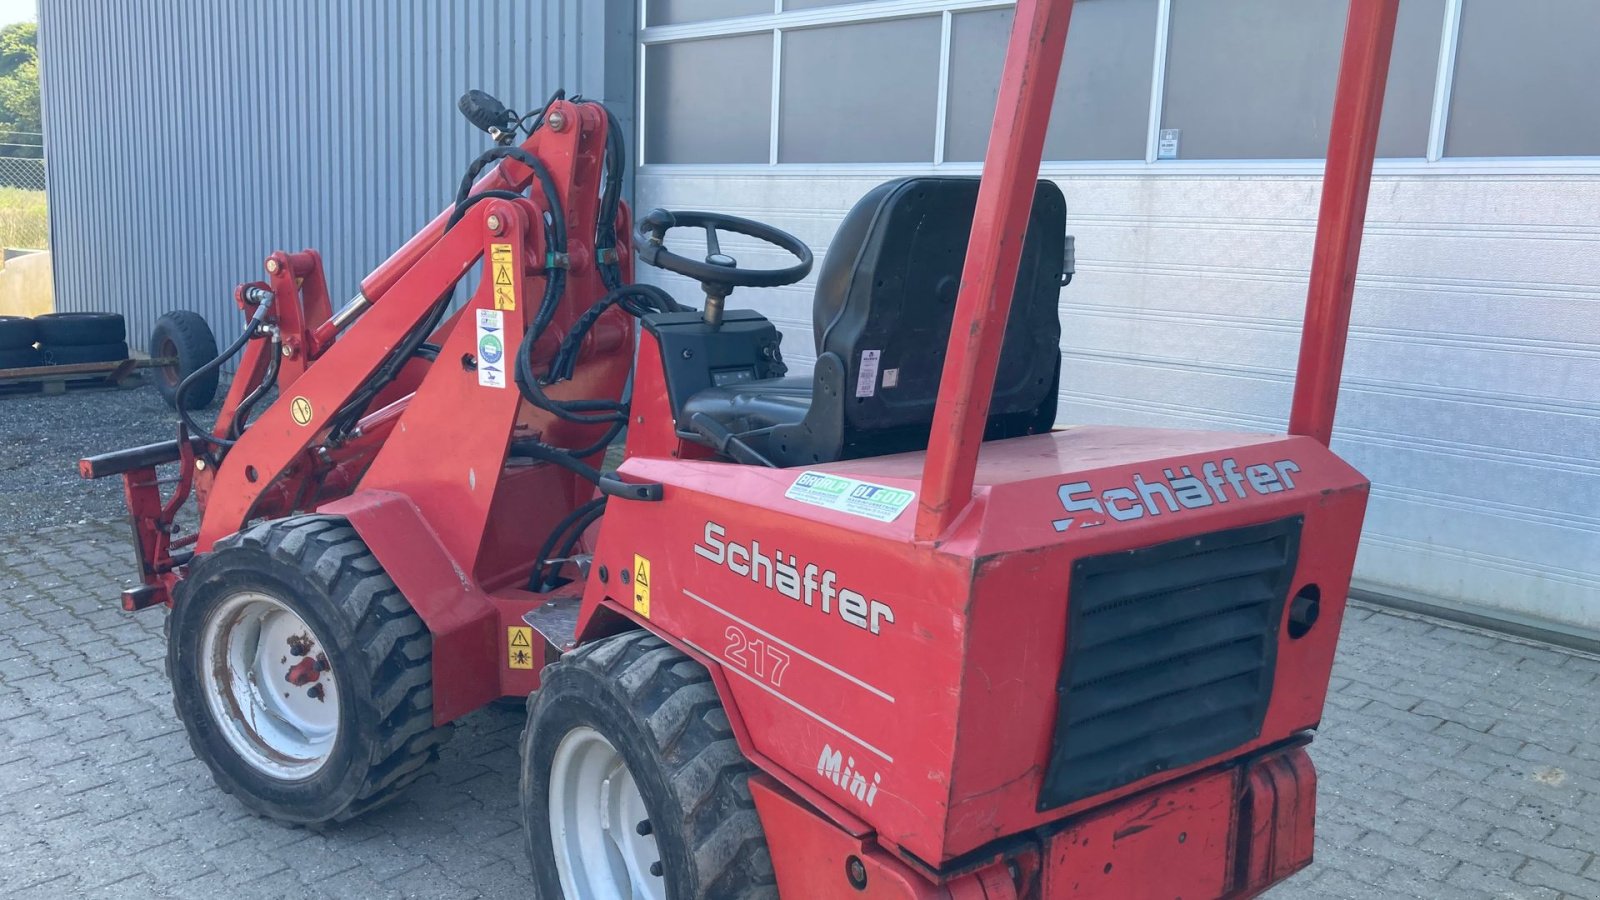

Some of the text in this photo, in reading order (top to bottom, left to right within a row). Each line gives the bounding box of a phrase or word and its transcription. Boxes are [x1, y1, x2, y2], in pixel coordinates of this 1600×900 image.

[1051, 458, 1302, 532] Schäffer
[694, 521, 895, 636] Schäffer
[725, 626, 790, 687] 217
[817, 744, 881, 807] Mini
